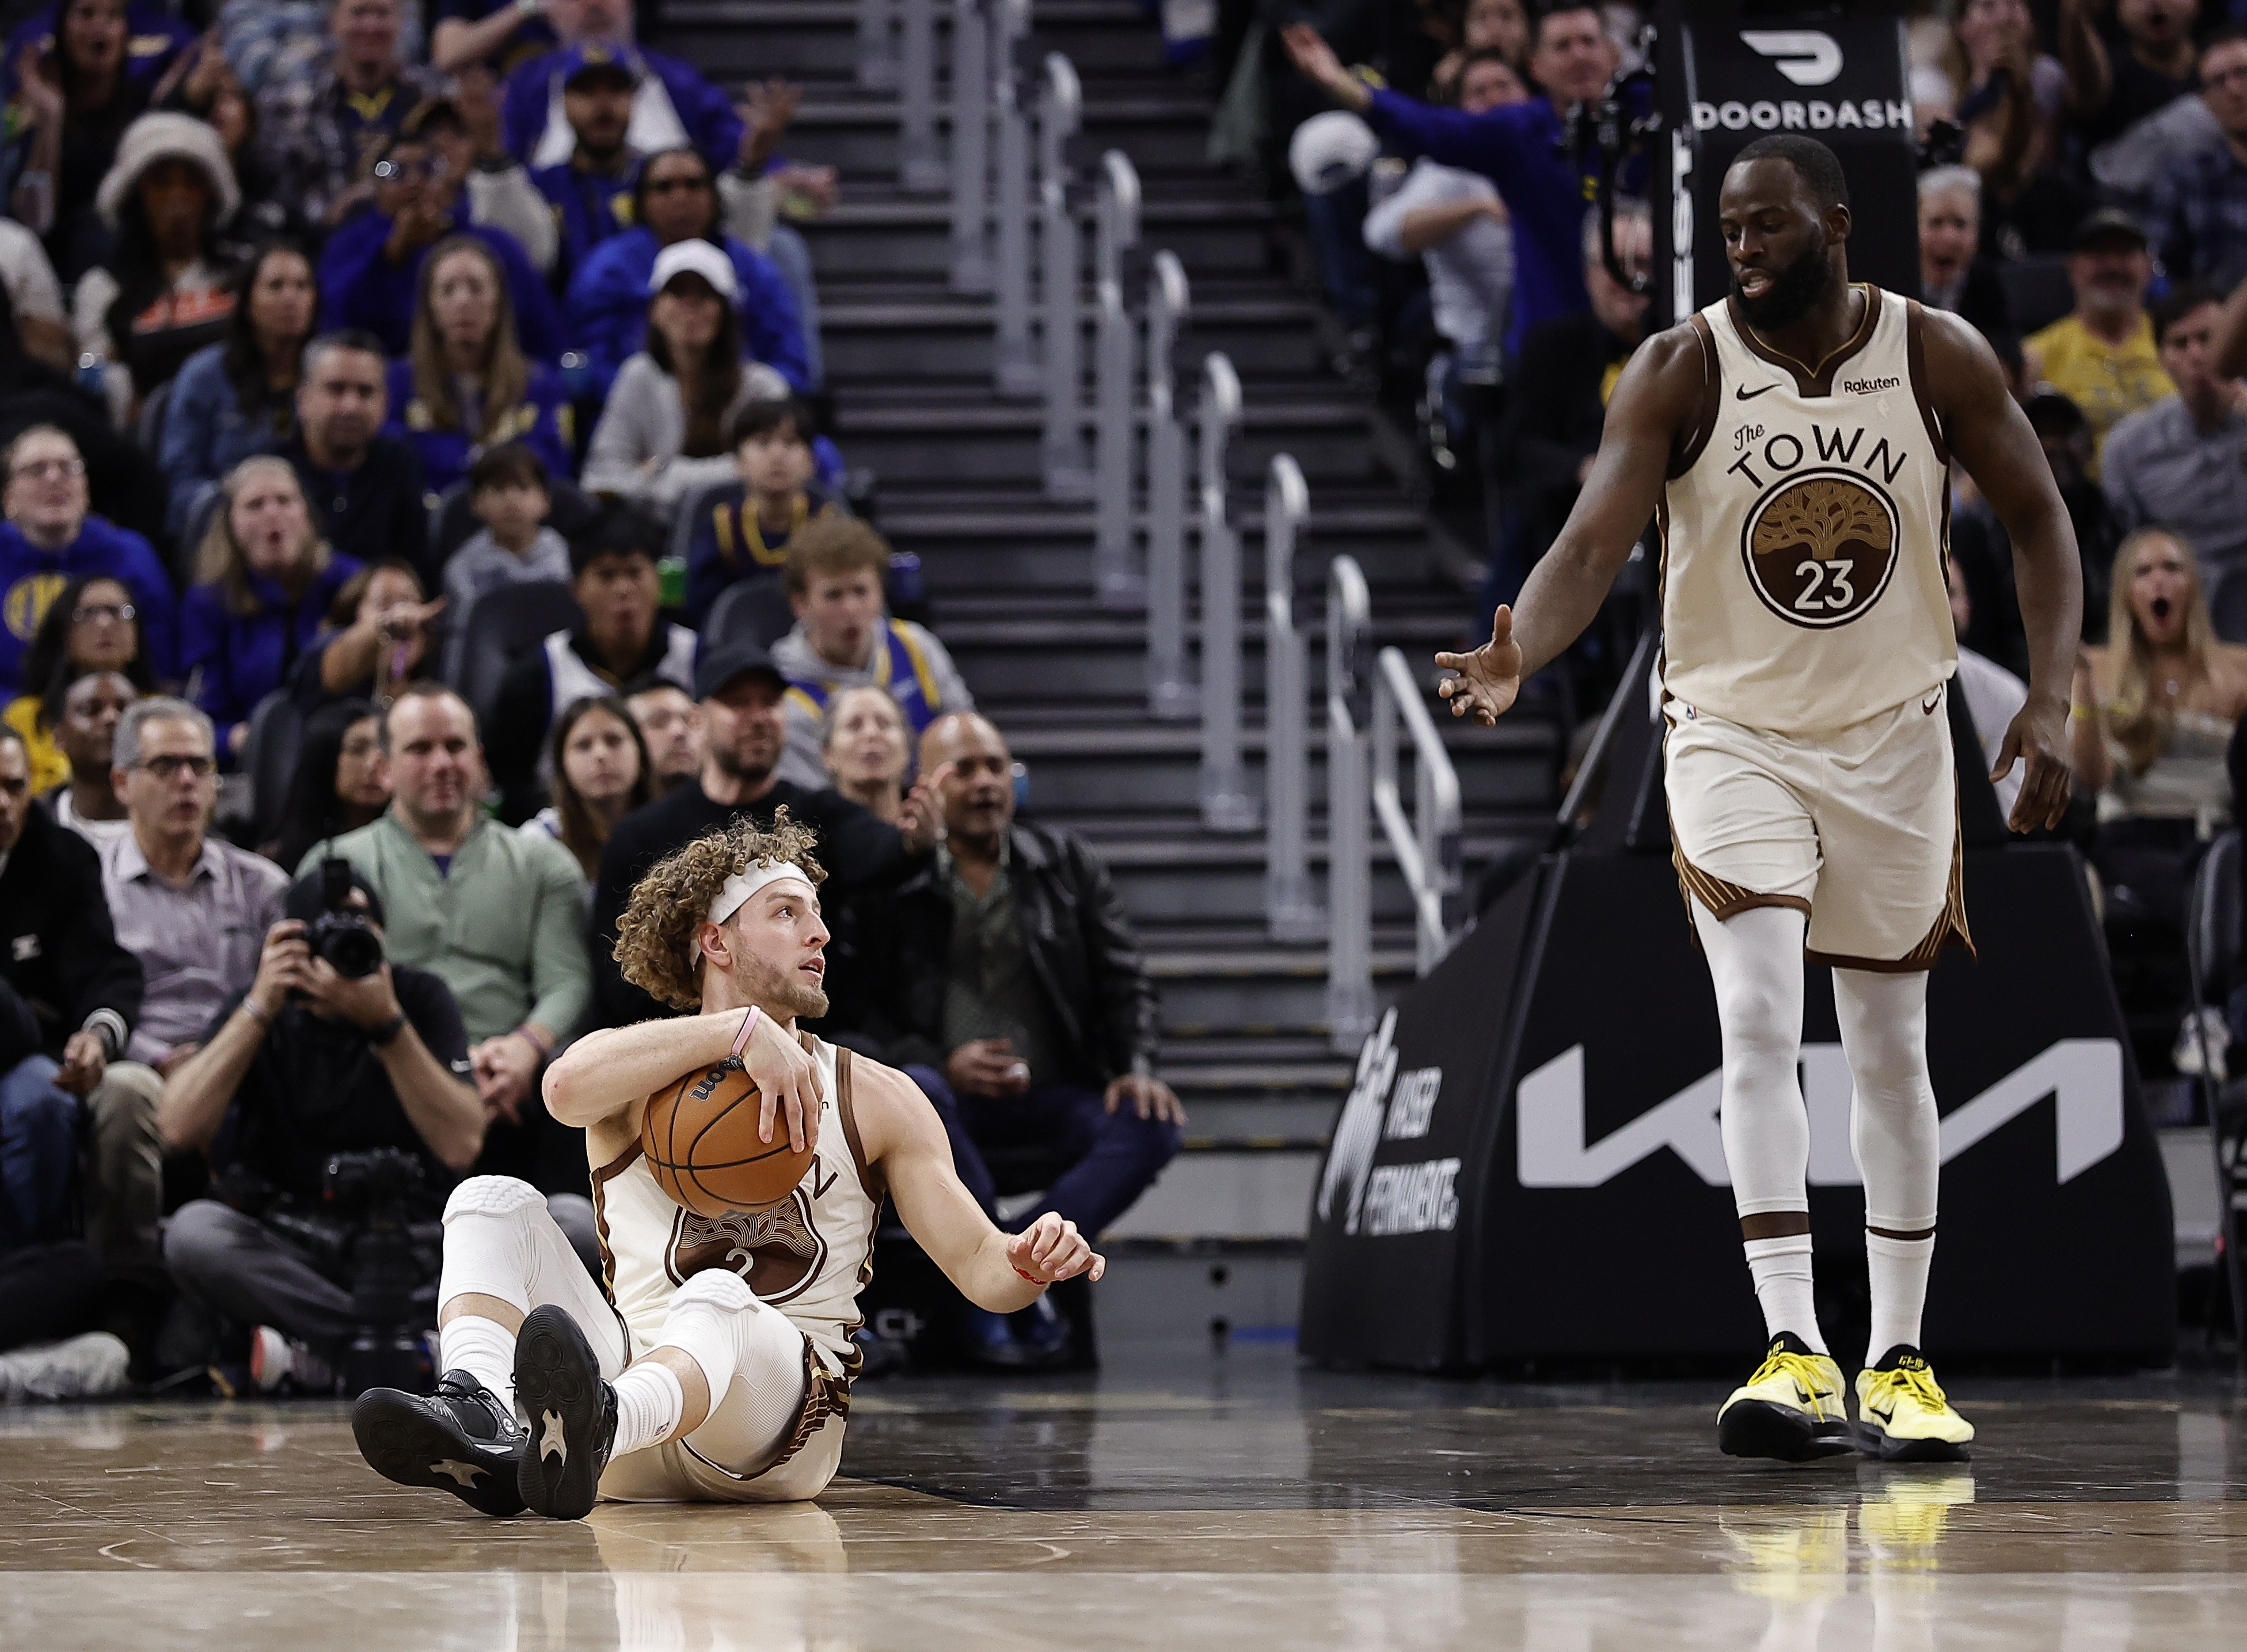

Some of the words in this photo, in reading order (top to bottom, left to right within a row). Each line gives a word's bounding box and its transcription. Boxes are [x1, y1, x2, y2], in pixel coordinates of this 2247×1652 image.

[1691, 100, 1913, 131] DOORDASH
[1844, 376, 1900, 395] Rakuten
[1734, 424, 1765, 451] The
[1727, 425, 1907, 489] TOWN
[1794, 559, 1854, 610] 23
